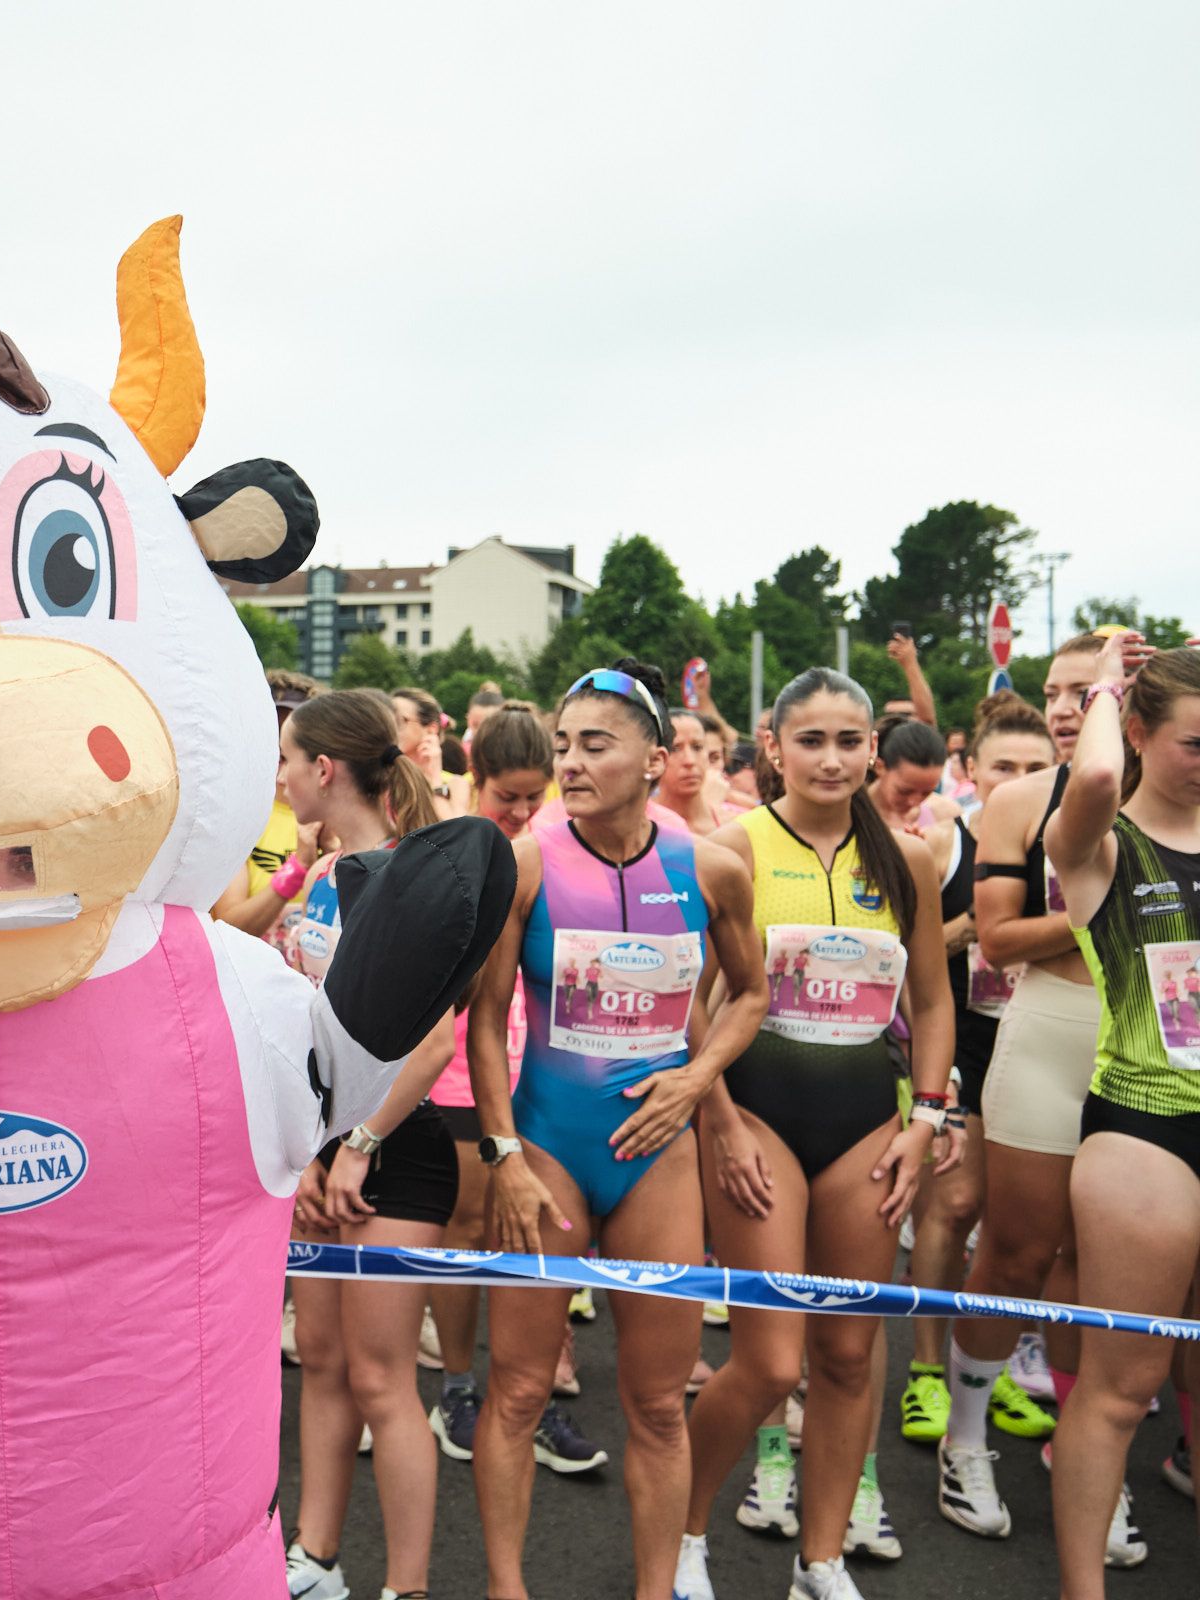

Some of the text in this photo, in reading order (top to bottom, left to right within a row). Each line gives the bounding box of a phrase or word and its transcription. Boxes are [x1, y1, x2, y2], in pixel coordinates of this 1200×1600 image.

[606, 952, 660, 966] ASTURIANA
[815, 944, 863, 956] ASTURIANA
[806, 980, 857, 1001] 016
[600, 991, 655, 1013] 016
[2, 1141, 65, 1156] LECHERA
[963, 1294, 1061, 1322] ASTURIANA
